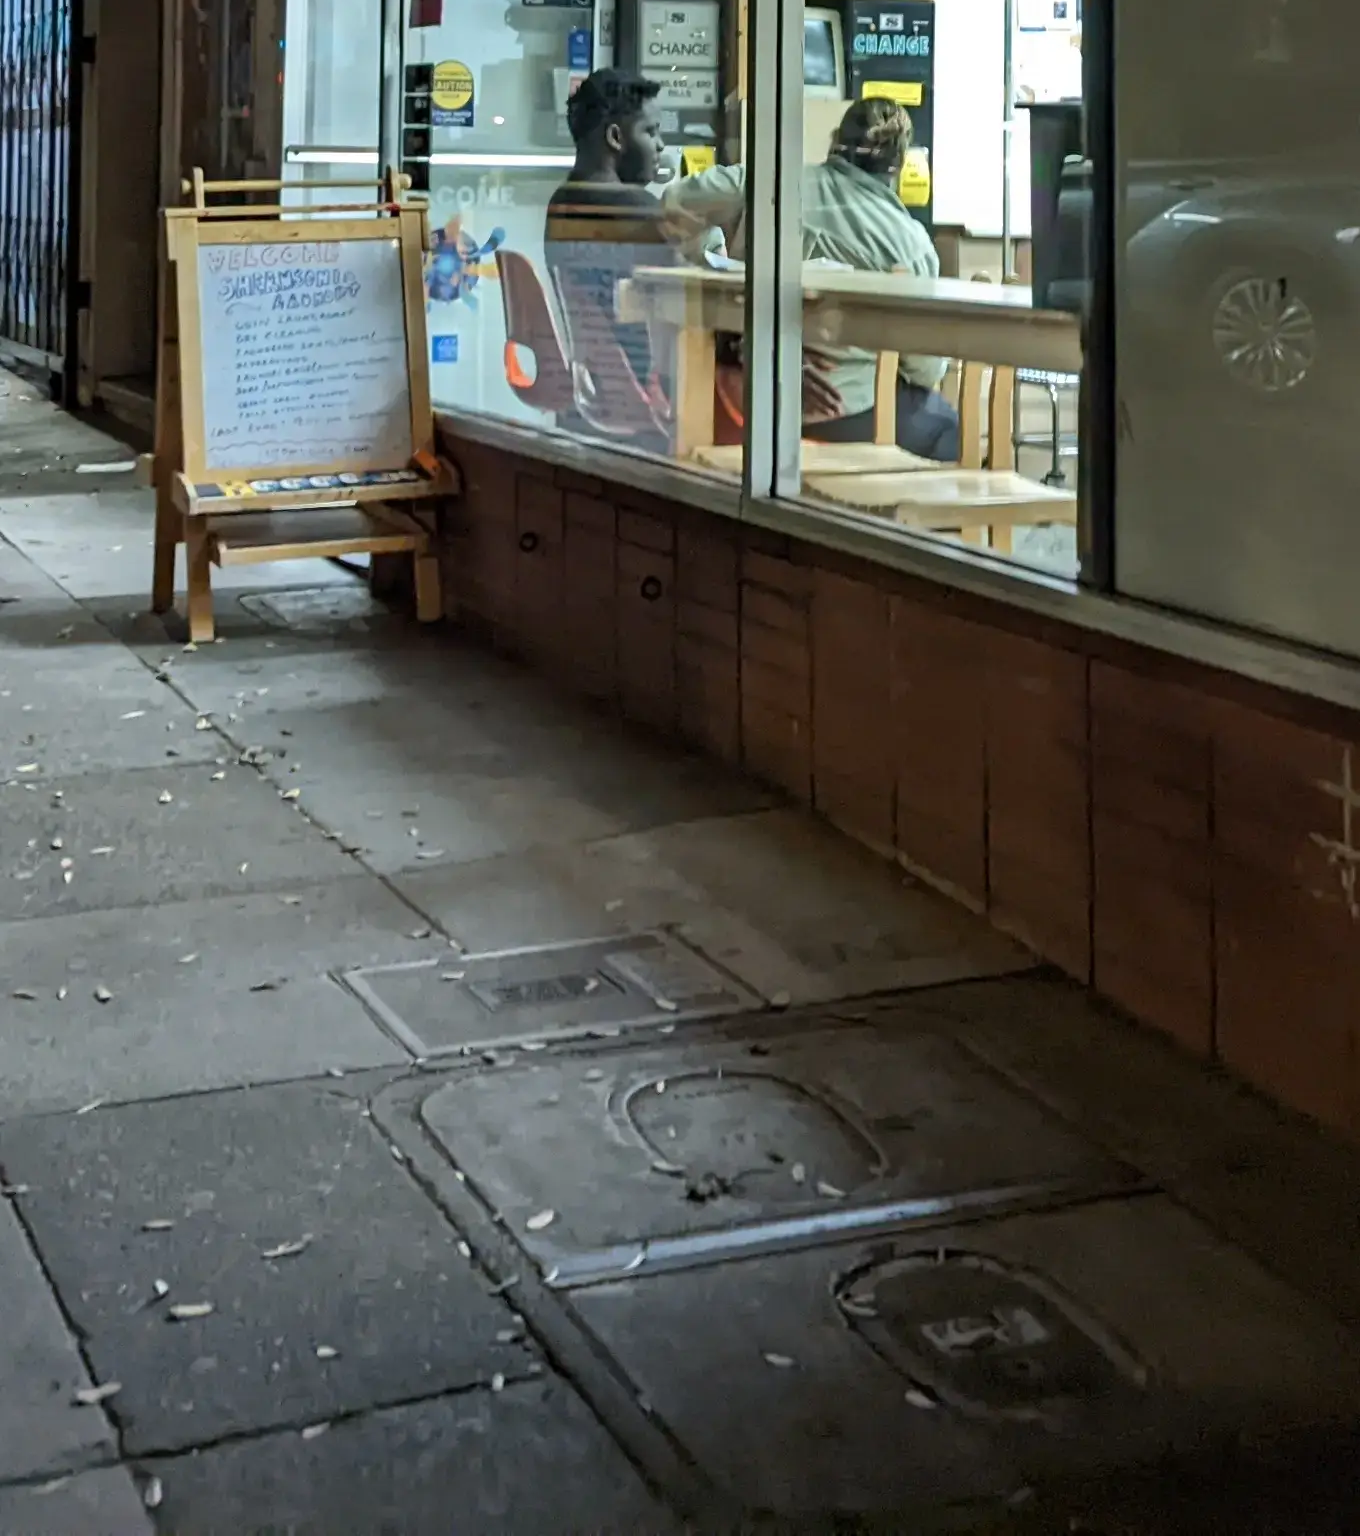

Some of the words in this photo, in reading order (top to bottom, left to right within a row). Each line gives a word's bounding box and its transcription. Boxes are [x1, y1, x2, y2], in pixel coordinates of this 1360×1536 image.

[649, 41, 711, 57] CHANGE
[853, 33, 930, 56] CHANGE
[207, 245, 340, 274] WELCOME
